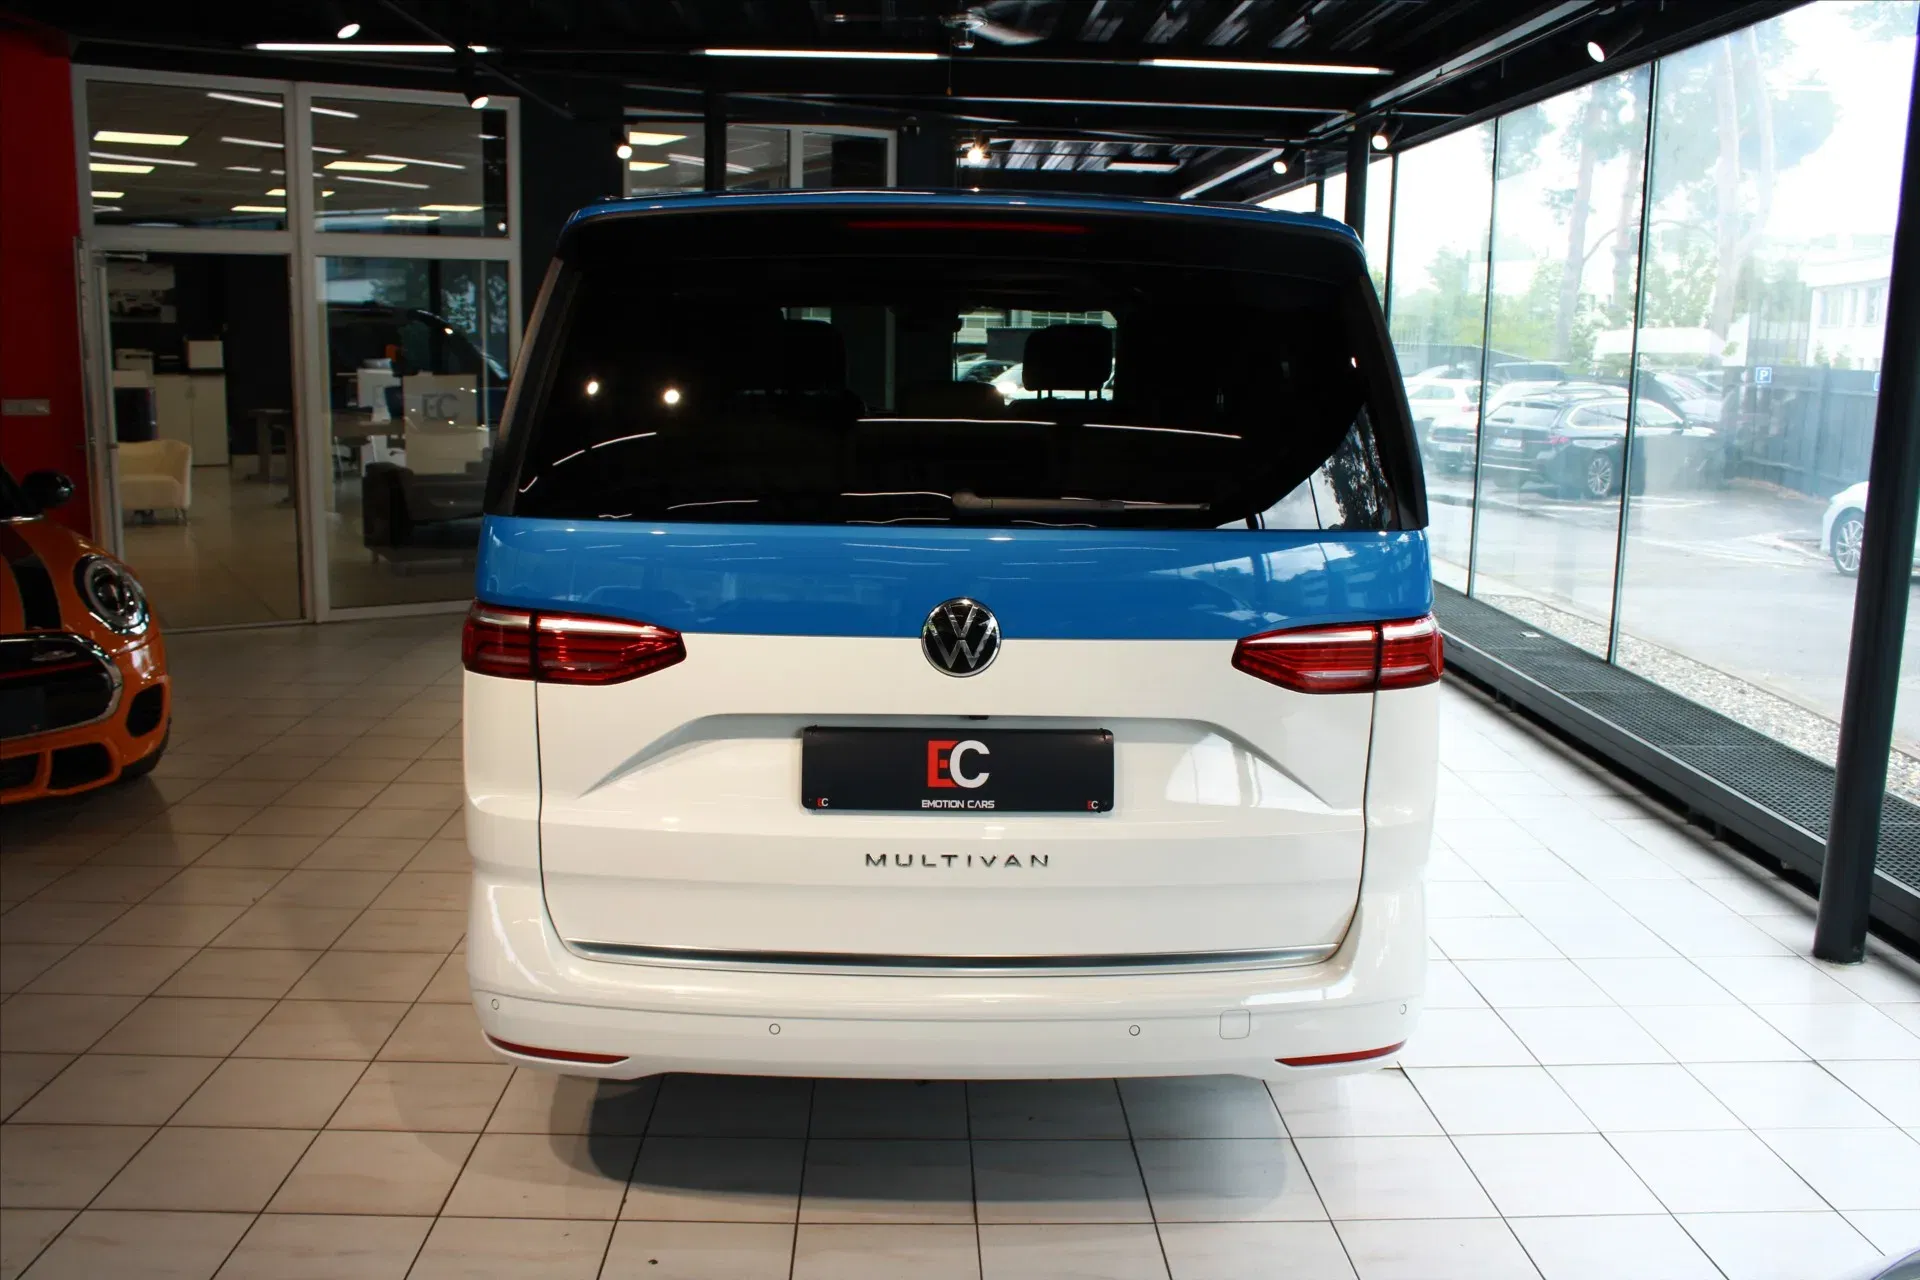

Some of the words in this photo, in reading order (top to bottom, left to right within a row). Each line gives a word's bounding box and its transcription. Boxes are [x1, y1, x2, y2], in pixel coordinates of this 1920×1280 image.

[927, 739, 990, 789] EC
[921, 799, 965, 809] EMOTION
[967, 800, 995, 809] CARS
[865, 853, 1049, 868] MULTIVAN
